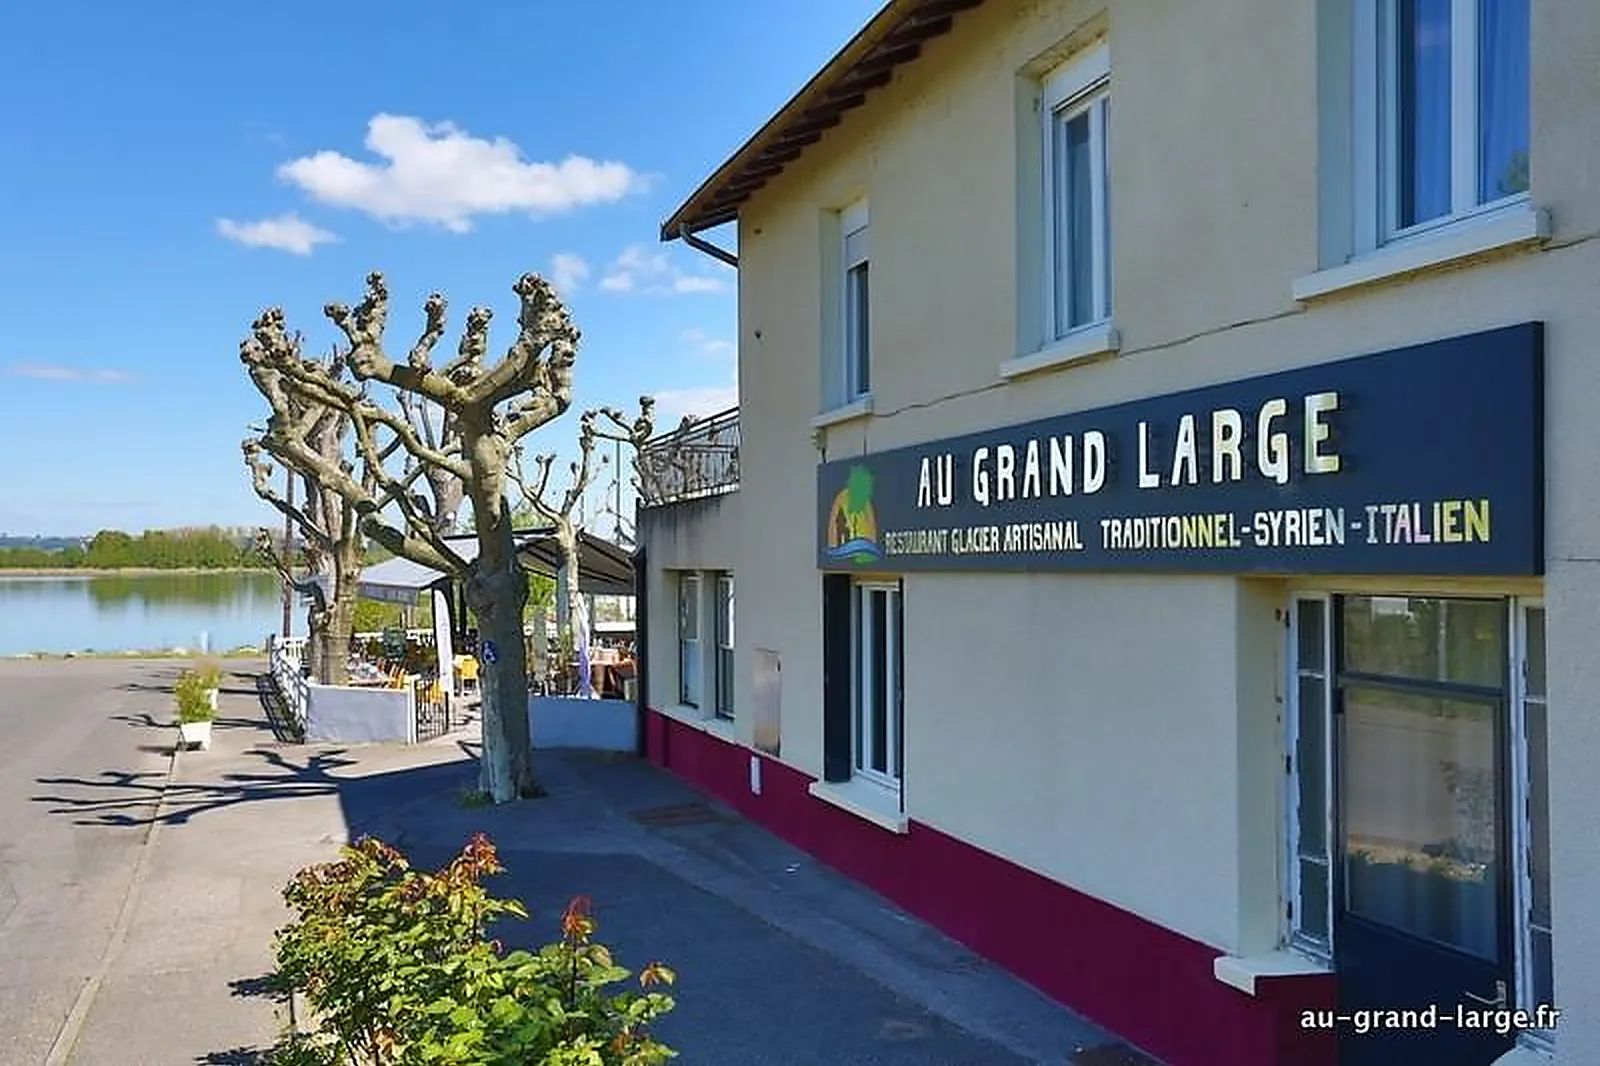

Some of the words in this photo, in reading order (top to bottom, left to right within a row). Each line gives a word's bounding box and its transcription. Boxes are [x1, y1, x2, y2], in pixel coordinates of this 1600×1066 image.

[917, 453, 953, 507] AU
[972, 431, 1106, 506] GRAND
[1138, 392, 1340, 488] LARGE
[885, 529, 949, 554] RESTAURANT
[951, 527, 999, 554] GLACIER
[1003, 521, 1083, 551] ARTISANAL
